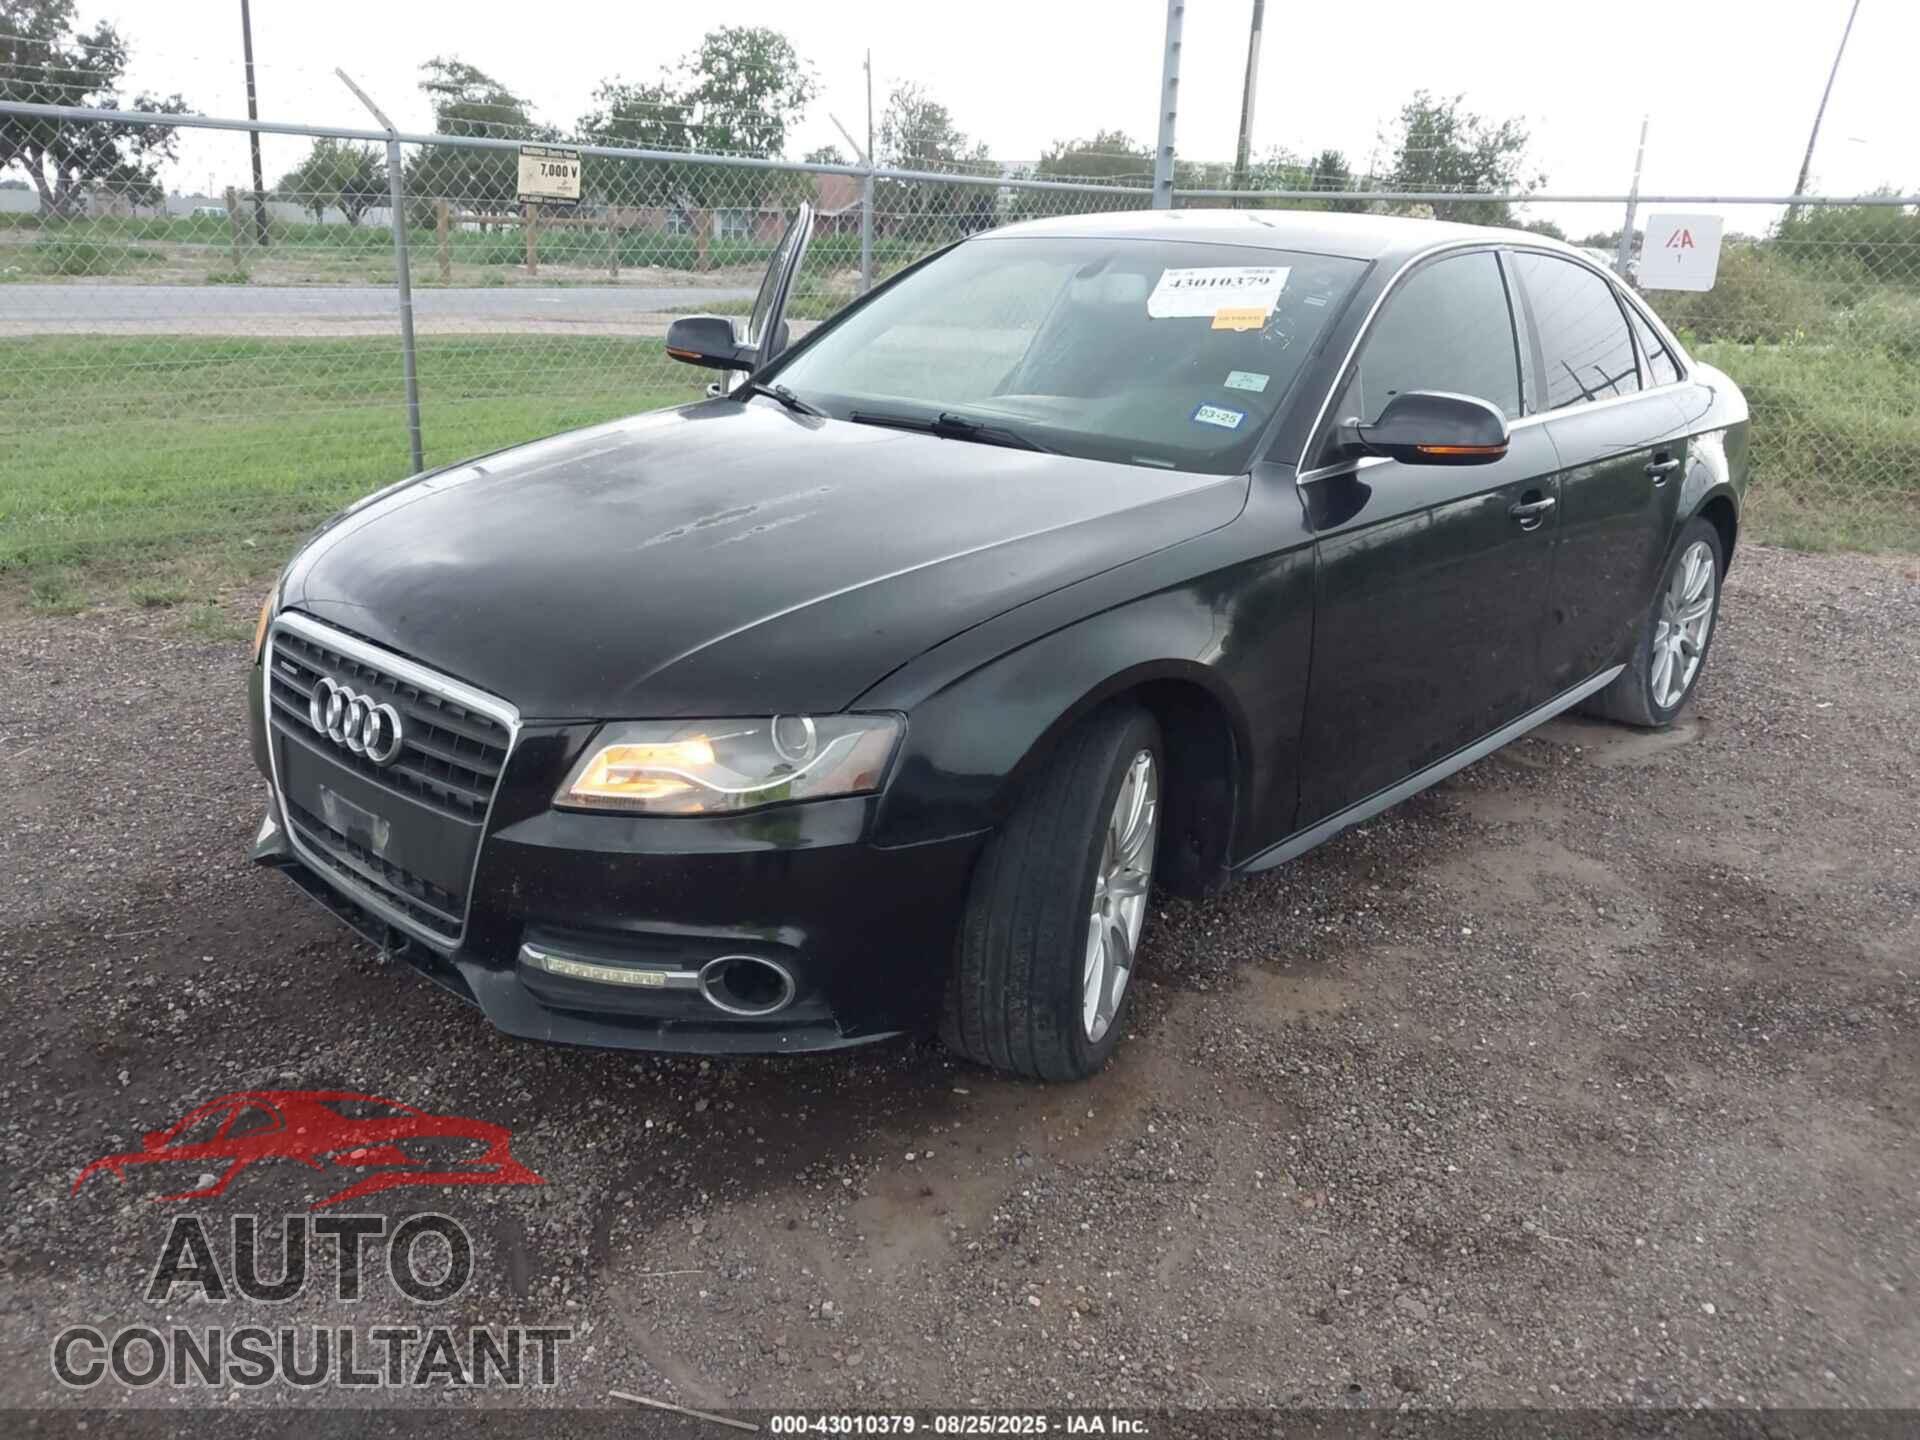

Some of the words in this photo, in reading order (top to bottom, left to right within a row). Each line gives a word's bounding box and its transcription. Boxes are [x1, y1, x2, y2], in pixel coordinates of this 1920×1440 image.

[541, 163, 568, 178] 7,000
[571, 166, 578, 178] V
[1168, 276, 1271, 289] 43010379
